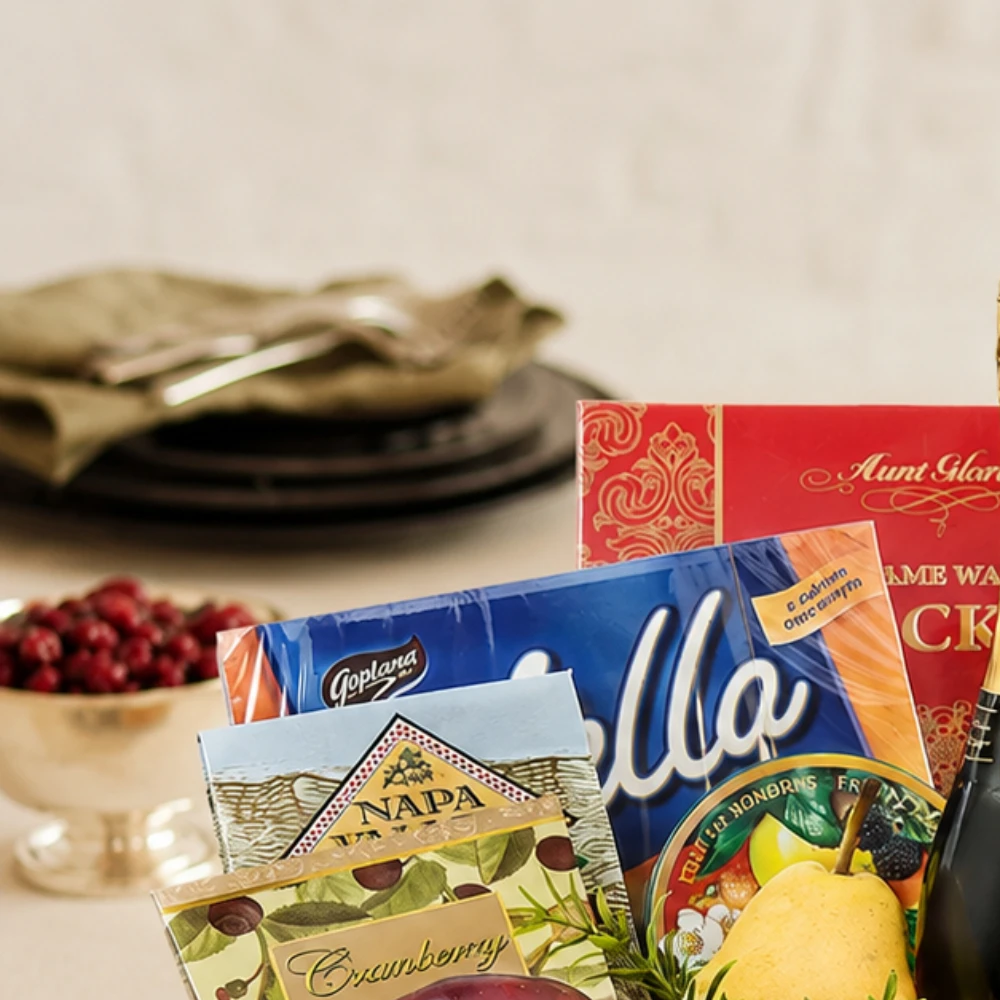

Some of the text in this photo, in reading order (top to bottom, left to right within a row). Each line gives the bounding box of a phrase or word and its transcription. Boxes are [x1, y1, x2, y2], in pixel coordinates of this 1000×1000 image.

[838, 453, 929, 483] Aunt
[329, 649, 418, 708] Goplana
[353, 785, 485, 825] NAPA
[287, 933, 510, 998] Cranberry
